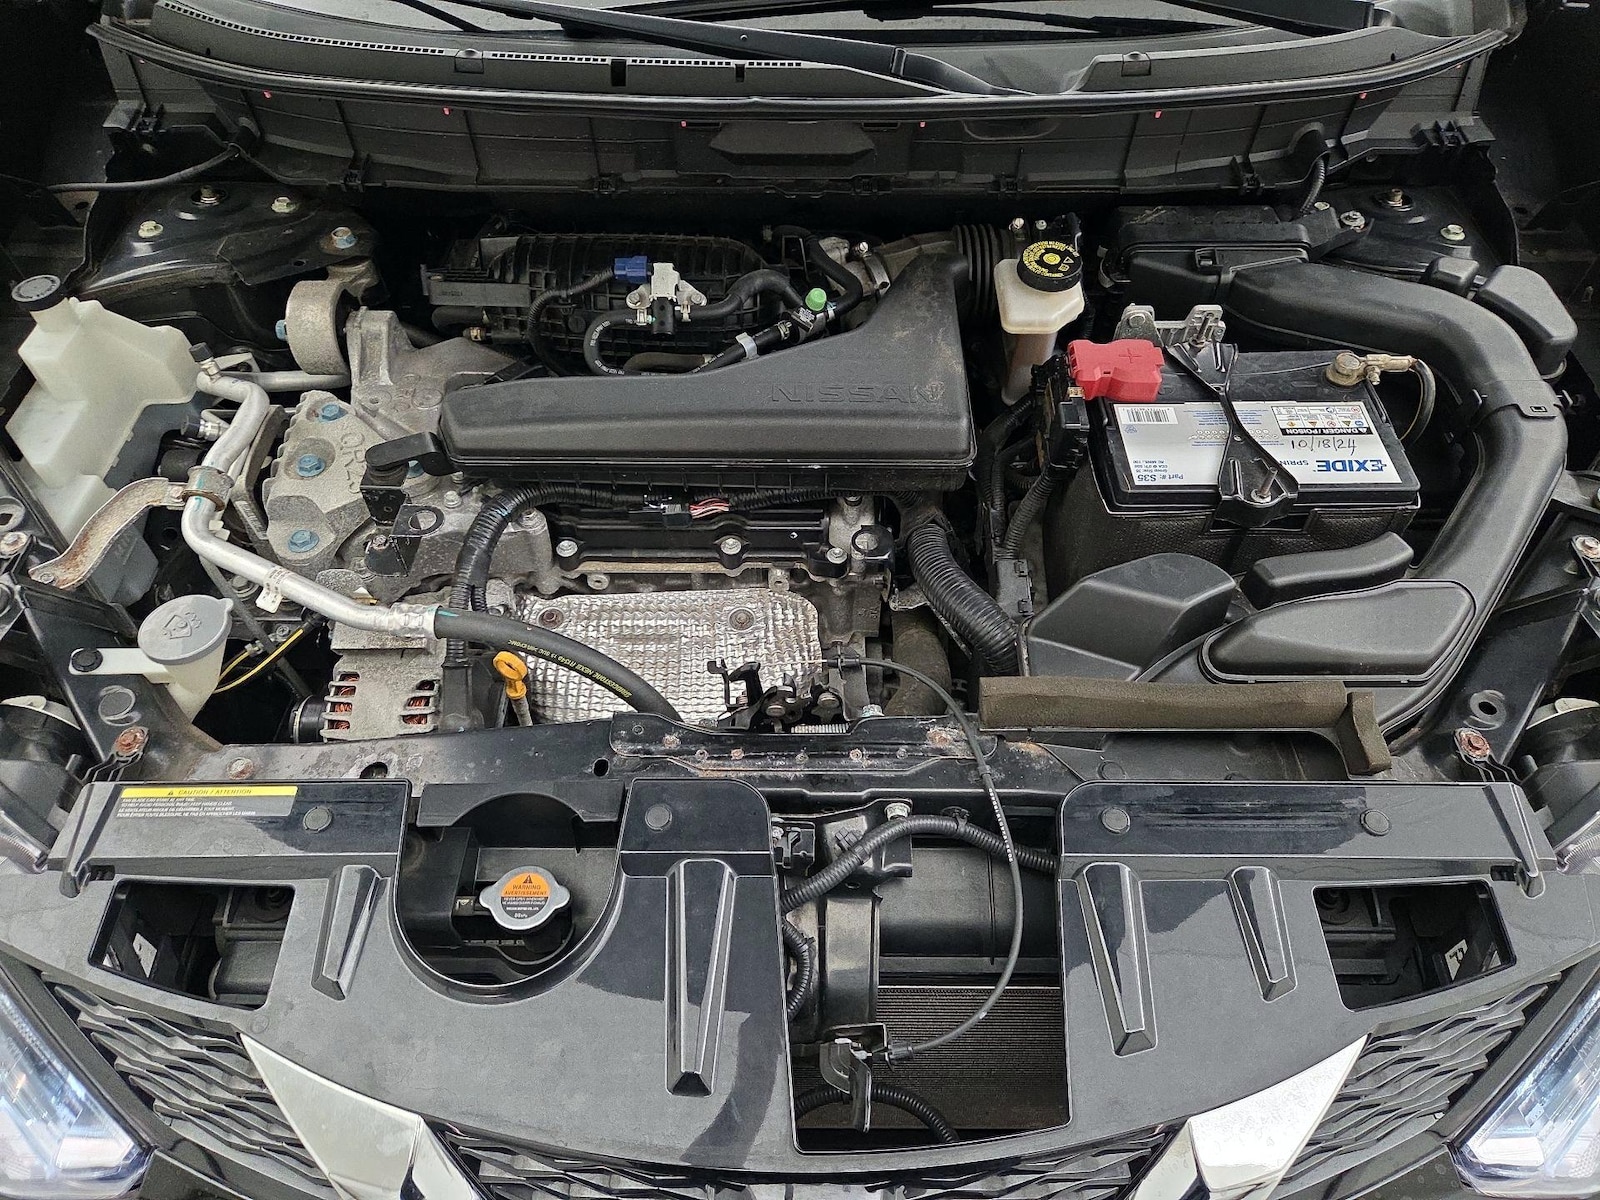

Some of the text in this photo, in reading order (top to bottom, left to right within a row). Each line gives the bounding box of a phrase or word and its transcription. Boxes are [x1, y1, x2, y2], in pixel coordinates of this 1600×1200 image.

[772, 382, 942, 404] NISSAN
[1292, 436, 1357, 456] 10/18/24
[1317, 460, 1387, 472] EXIDE
[592, 670, 632, 698] BRIDGESTONE
